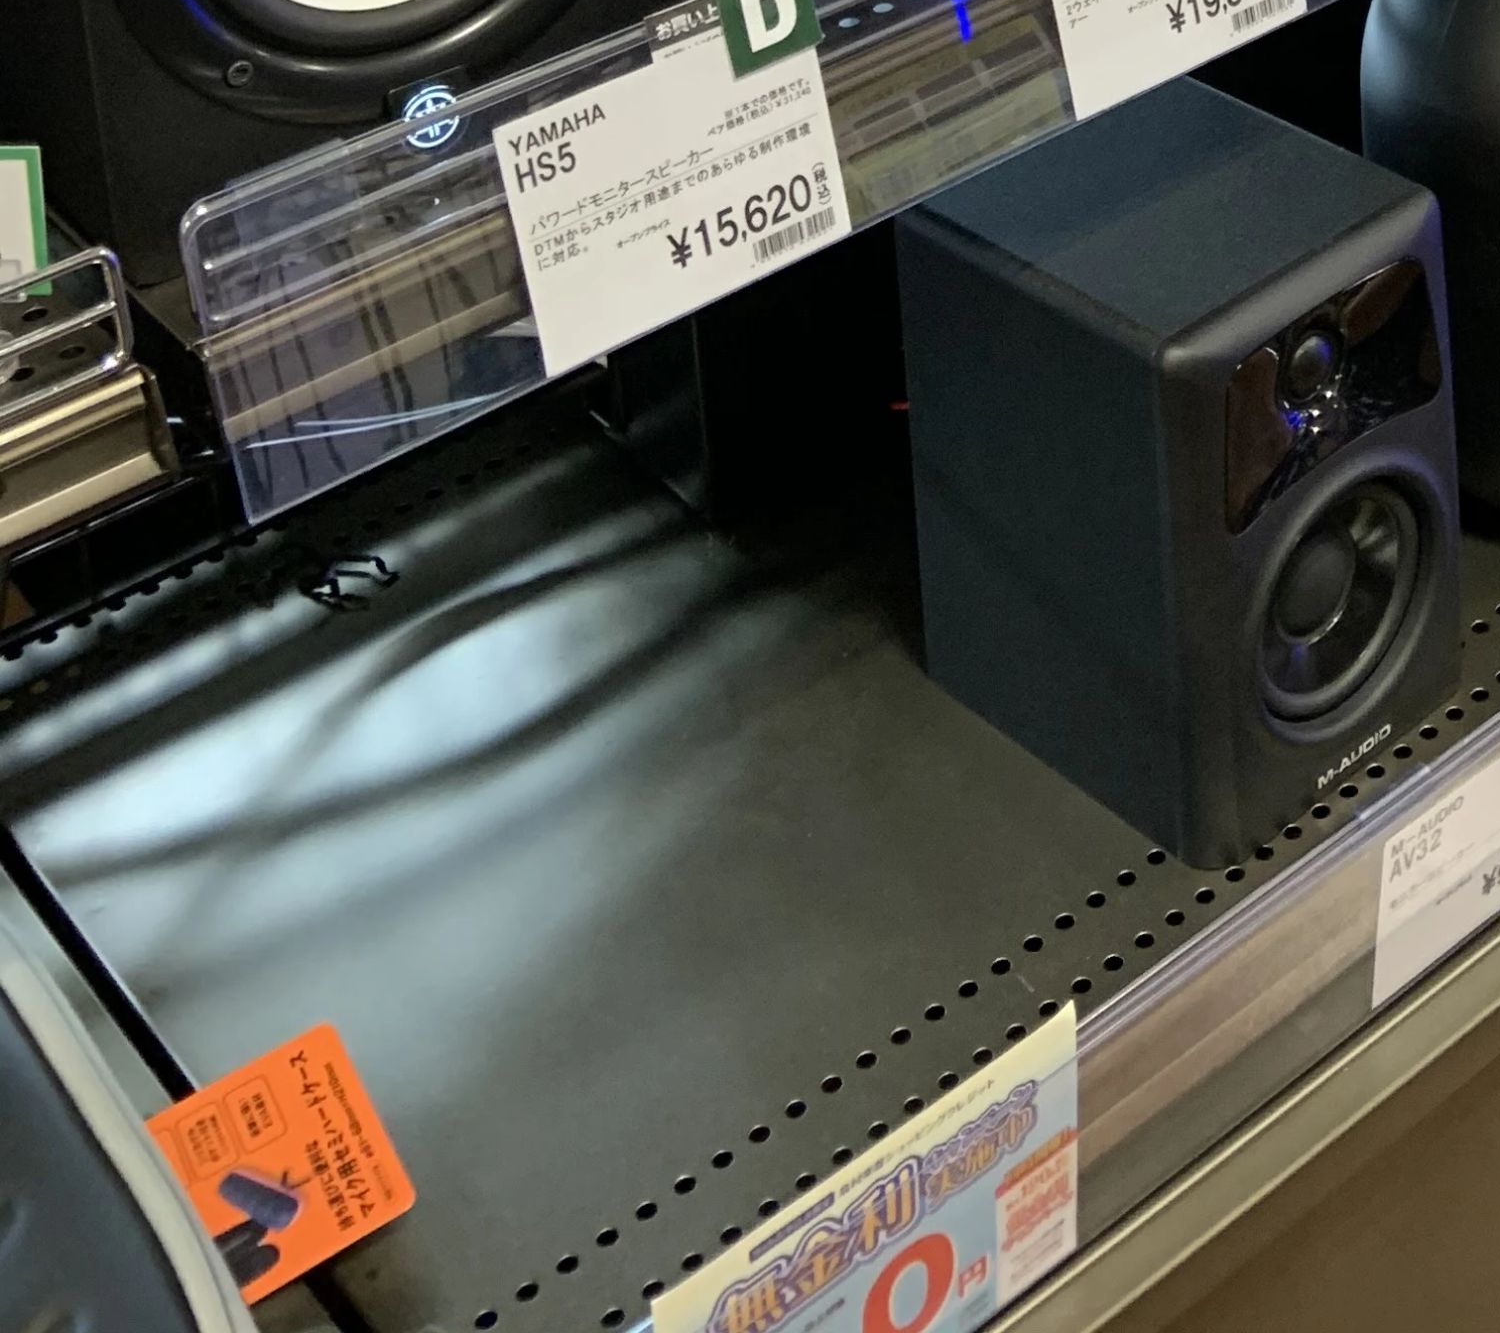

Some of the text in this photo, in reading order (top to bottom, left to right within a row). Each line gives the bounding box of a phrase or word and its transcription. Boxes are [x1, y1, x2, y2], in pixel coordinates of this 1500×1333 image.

[508, 103, 607, 156] YAMAHA
[515, 142, 576, 194] HS5
[531, 146, 714, 233] パワードモニタースピーカー
[667, 174, 812, 269] ¥15,620
[538, 244, 589, 271] に対応。
[1317, 724, 1392, 789] M-AUDIO
[1389, 829, 1443, 883] AV32
[1391, 795, 1464, 859] M-AUDIO
[289, 1049, 375, 1220] マイク用セミハードケース
